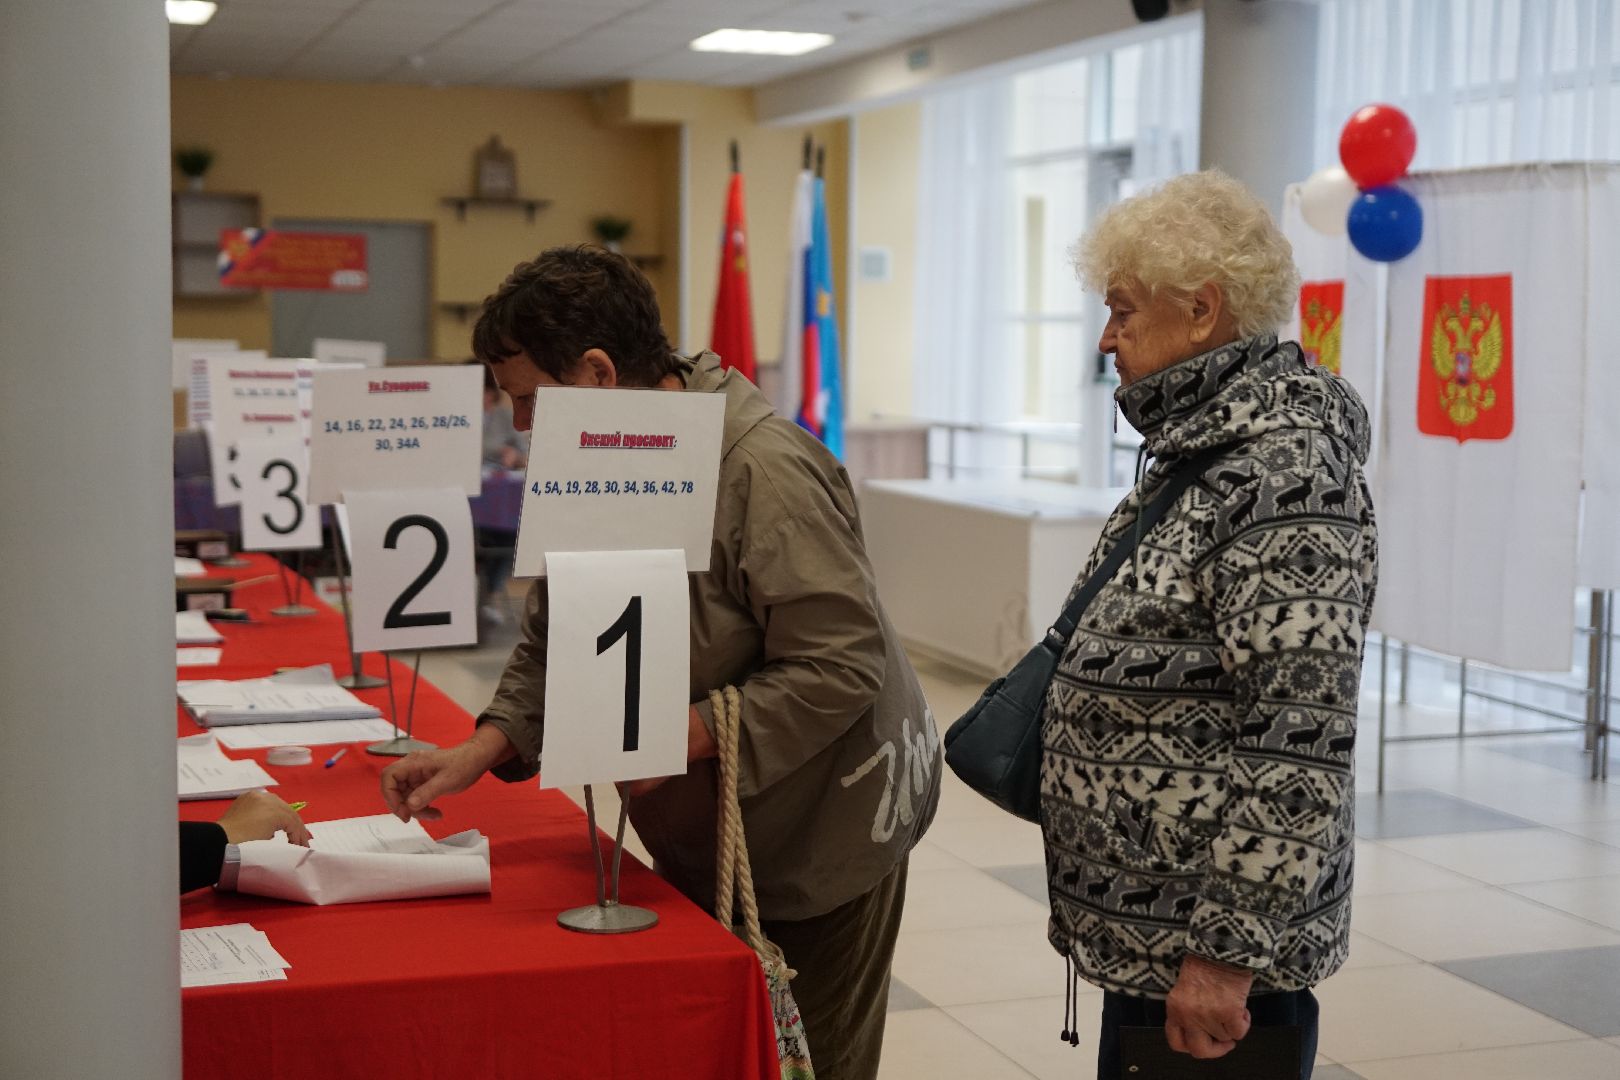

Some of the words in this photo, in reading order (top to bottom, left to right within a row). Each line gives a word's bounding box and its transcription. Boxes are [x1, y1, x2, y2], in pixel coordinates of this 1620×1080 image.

[325, 420, 342, 433] 14,
[346, 419, 364, 432] 16,
[368, 418, 386, 431] 22,
[389, 417, 407, 430] 24,
[411, 416, 429, 429] 26,
[432, 415, 470, 429] 28/26,
[375, 439, 393, 451] 30,
[580, 431, 621, 447] Окский
[622, 434, 677, 449] проспект:
[261, 458, 304, 535] 3
[531, 481, 541, 495] 4,
[565, 481, 581, 495] 19,
[585, 481, 601, 495] 28,
[604, 481, 620, 495] 30,
[623, 481, 639, 495] 34,
[642, 481, 658, 495] 36,
[661, 481, 677, 495] 42,
[681, 481, 694, 493] 78
[383, 514, 452, 629] 2
[596, 595, 642, 752] 1
